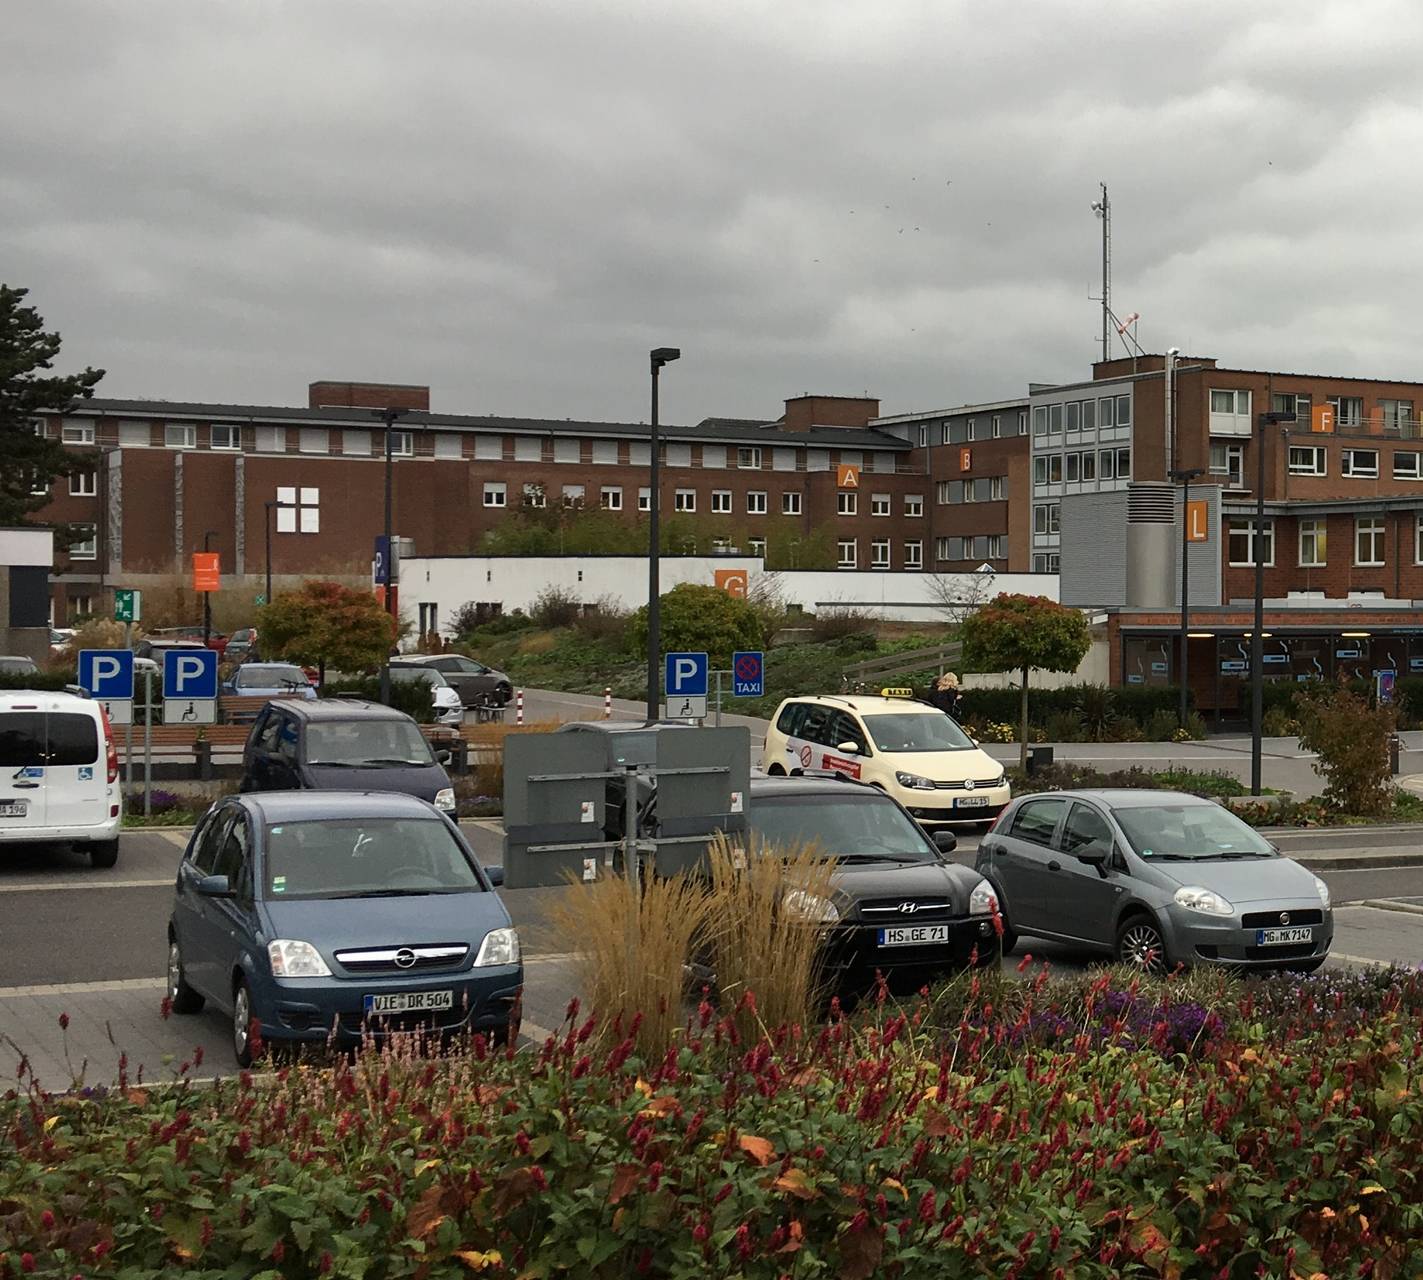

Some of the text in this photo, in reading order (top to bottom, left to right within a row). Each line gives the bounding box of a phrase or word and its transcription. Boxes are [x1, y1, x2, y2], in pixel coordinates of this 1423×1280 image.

[1322, 412, 1331, 430] F
[964, 453, 971, 470] B
[842, 469, 858, 487] A
[1193, 509, 1205, 537] L
[92, 656, 121, 692] P
[176, 656, 205, 692] P
[675, 658, 698, 690] P
[736, 682, 760, 693] TAXI
[9, 805, 26, 814] 196
[888, 927, 945, 942] HS GE 71
[1264, 929, 1311, 943] MG MK 7147
[374, 992, 450, 1010] VIE DR 504
